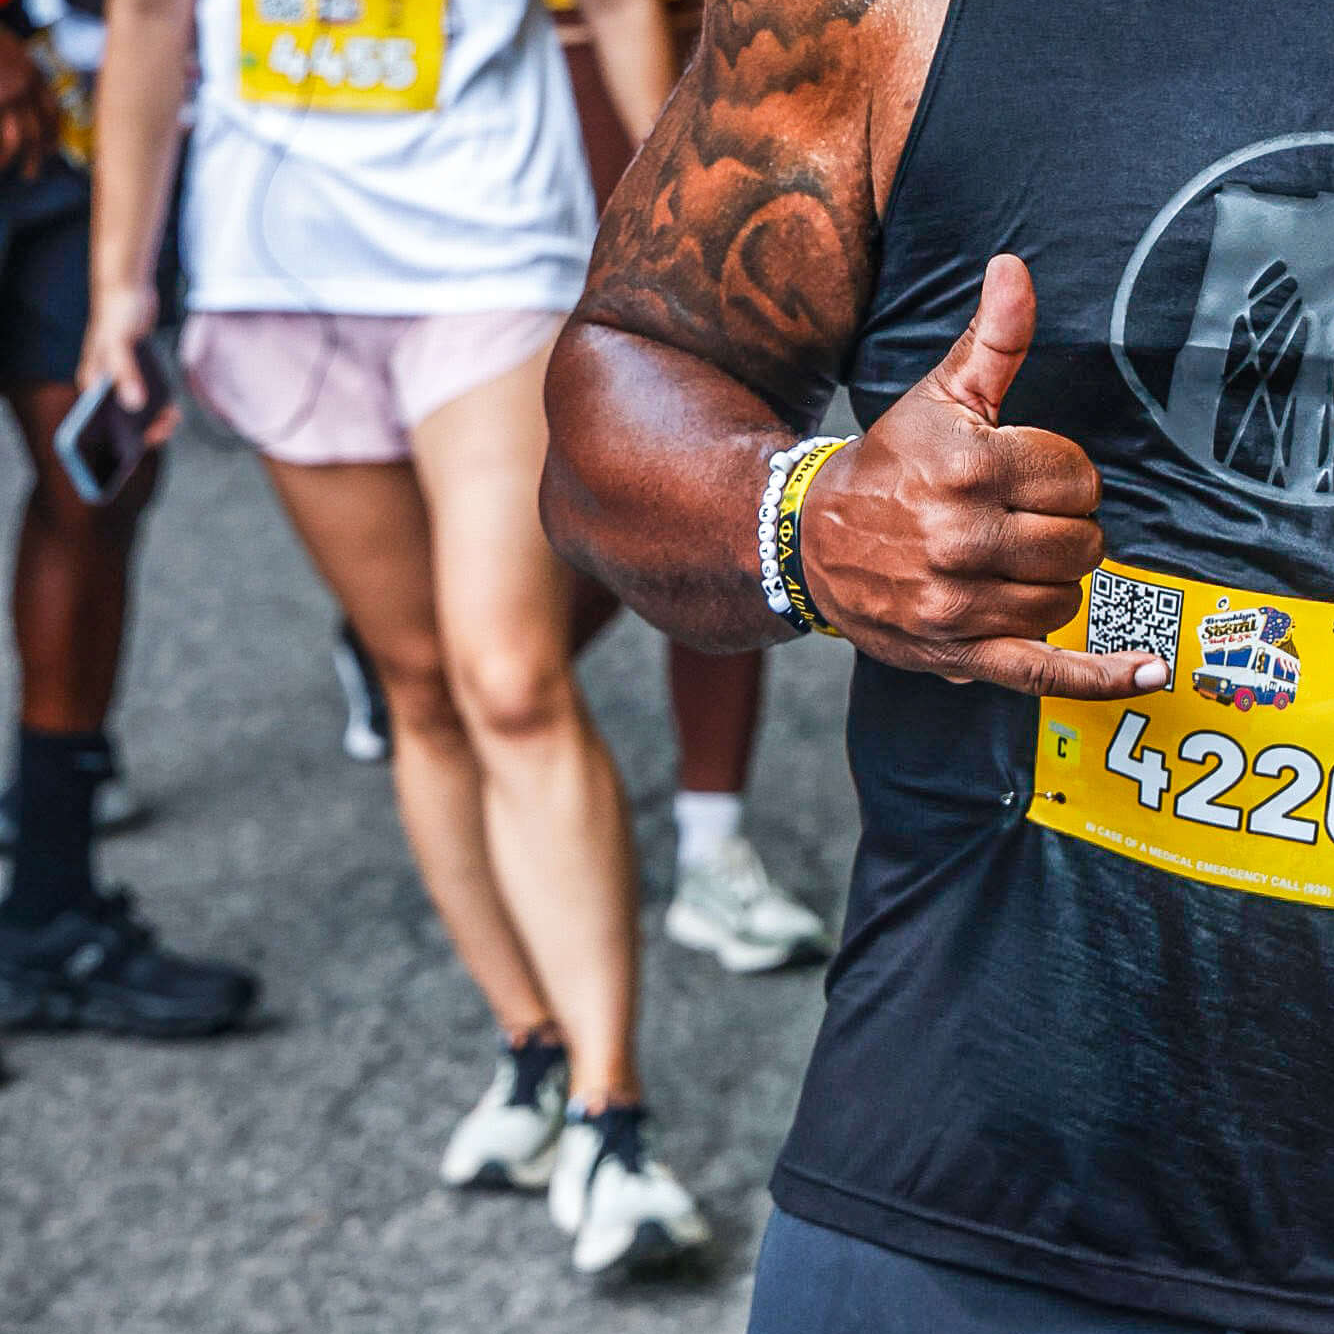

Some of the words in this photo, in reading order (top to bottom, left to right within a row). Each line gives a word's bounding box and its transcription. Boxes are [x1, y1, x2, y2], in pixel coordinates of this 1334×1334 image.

[785, 574, 816, 621] Alph
[1201, 619, 1258, 640] Social
[1057, 736, 1068, 759] C
[1097, 825, 1122, 844] CASE
[1124, 835, 1138, 849] OF
[1139, 842, 1148, 853] A
[1148, 845, 1193, 869] MEDICAL
[1195, 859, 1268, 884] EMERGENCY
[1270, 875, 1300, 892] CALL
